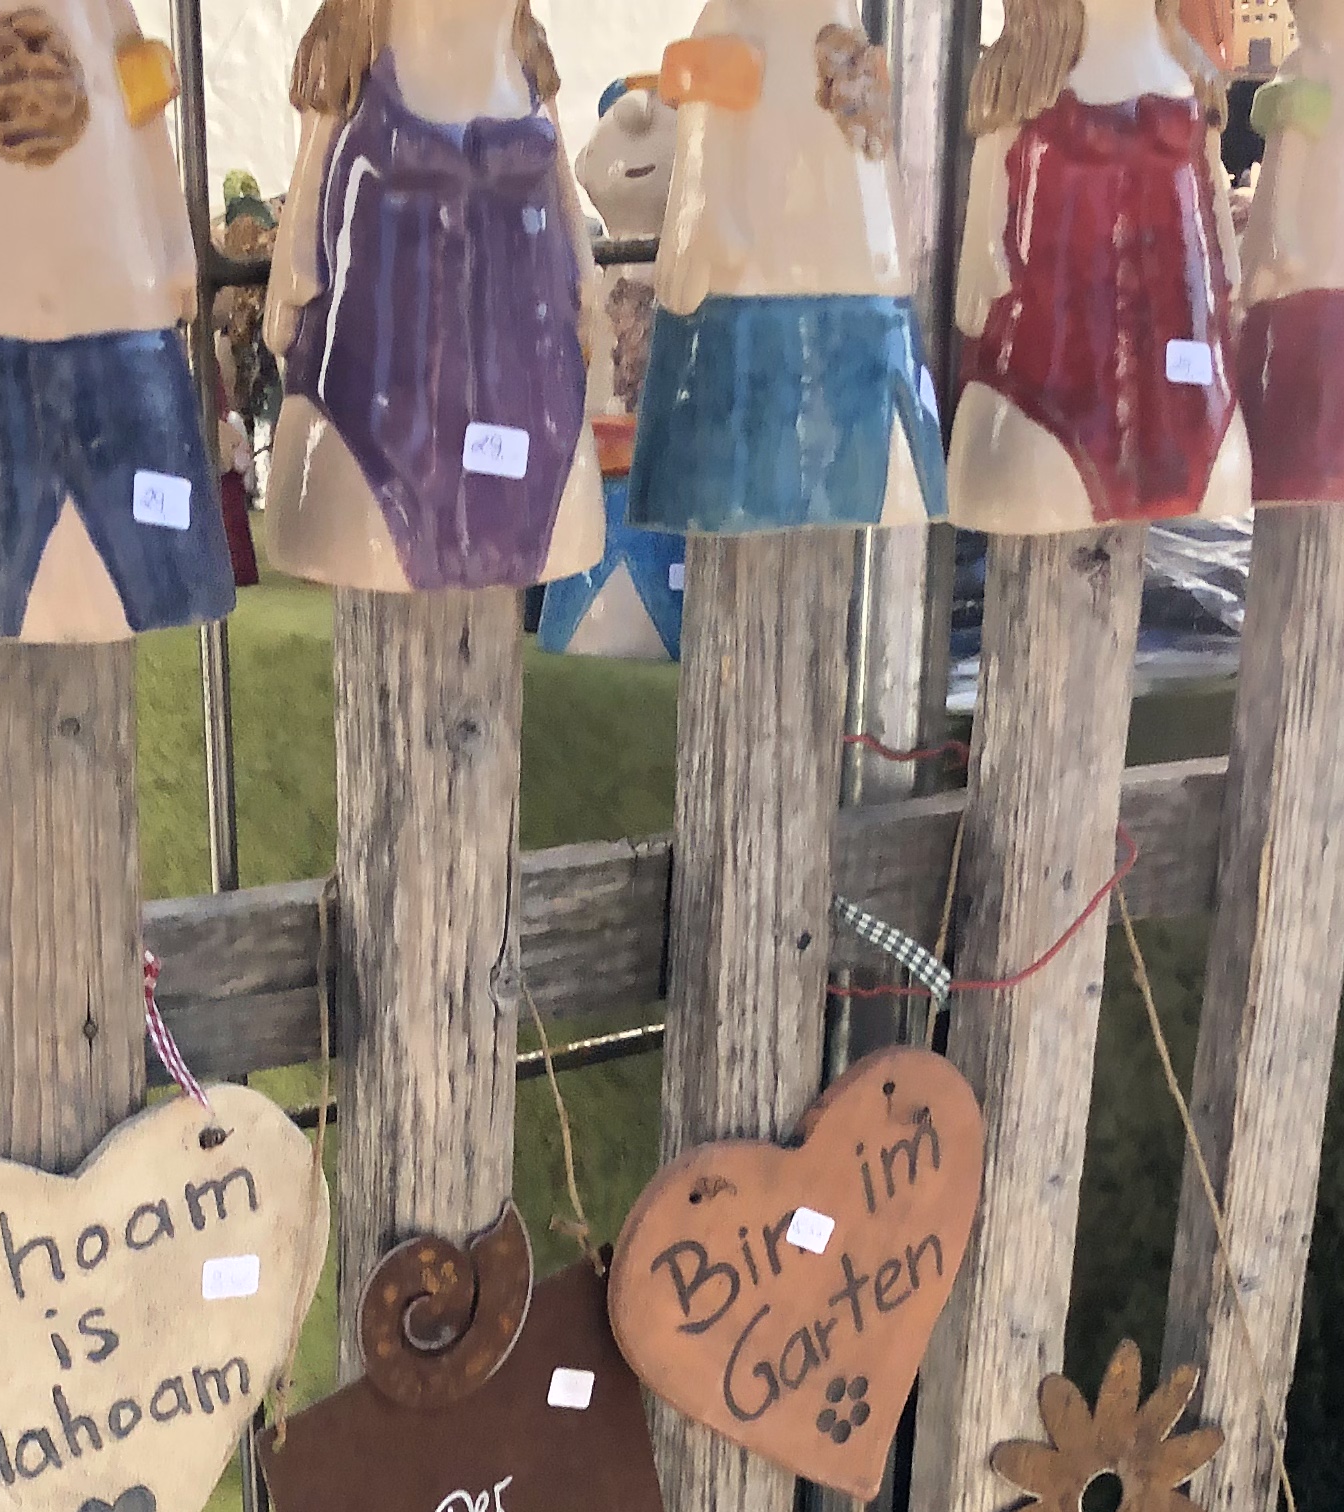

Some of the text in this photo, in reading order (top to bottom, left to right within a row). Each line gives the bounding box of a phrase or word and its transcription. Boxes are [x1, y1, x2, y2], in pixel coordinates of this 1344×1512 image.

[856, 1125, 941, 1214] im
[44, 1306, 121, 1371] is
[723, 1233, 944, 1423] Garten
